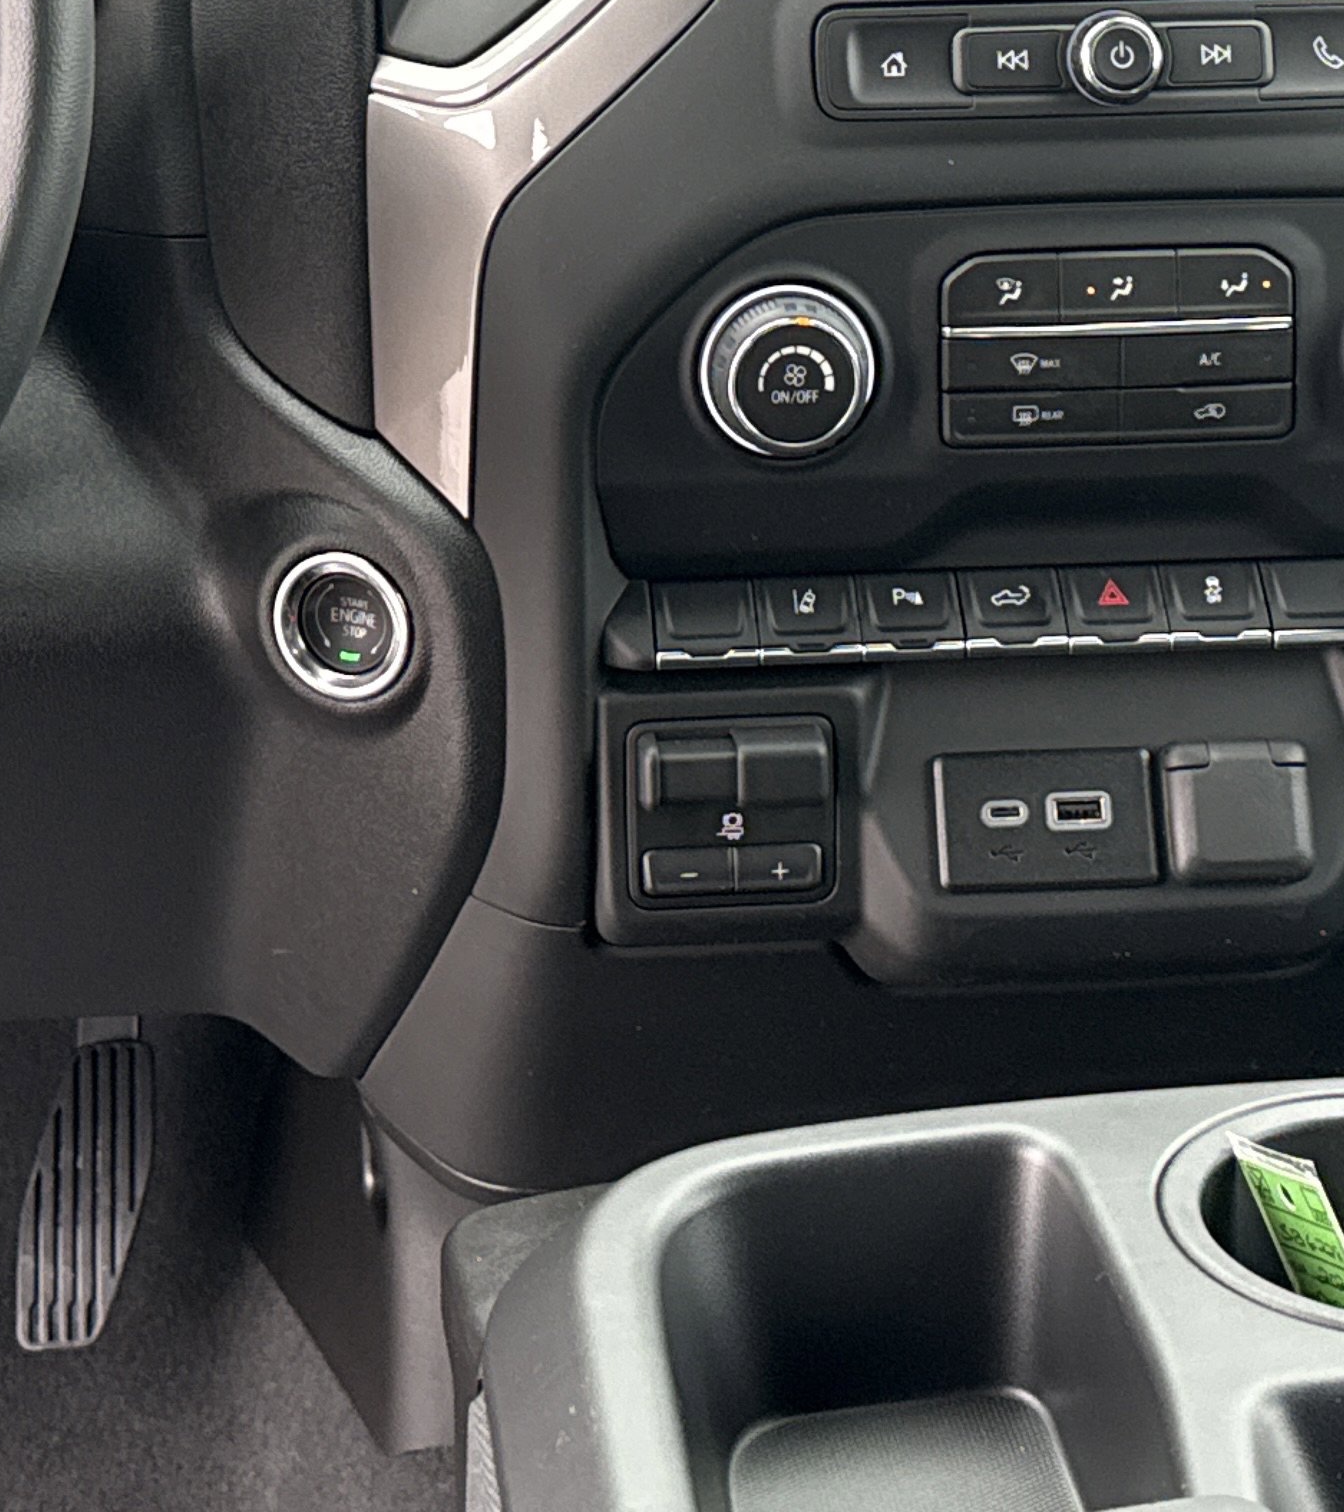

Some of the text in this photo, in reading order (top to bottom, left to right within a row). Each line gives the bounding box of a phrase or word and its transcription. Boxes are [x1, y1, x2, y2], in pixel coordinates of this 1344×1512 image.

[1198, 352, 1223, 366] A/C
[770, 389, 820, 405] ON/OFF
[340, 596, 369, 610] START
[330, 608, 377, 629] ENGINE
[342, 624, 367, 638] STOP
